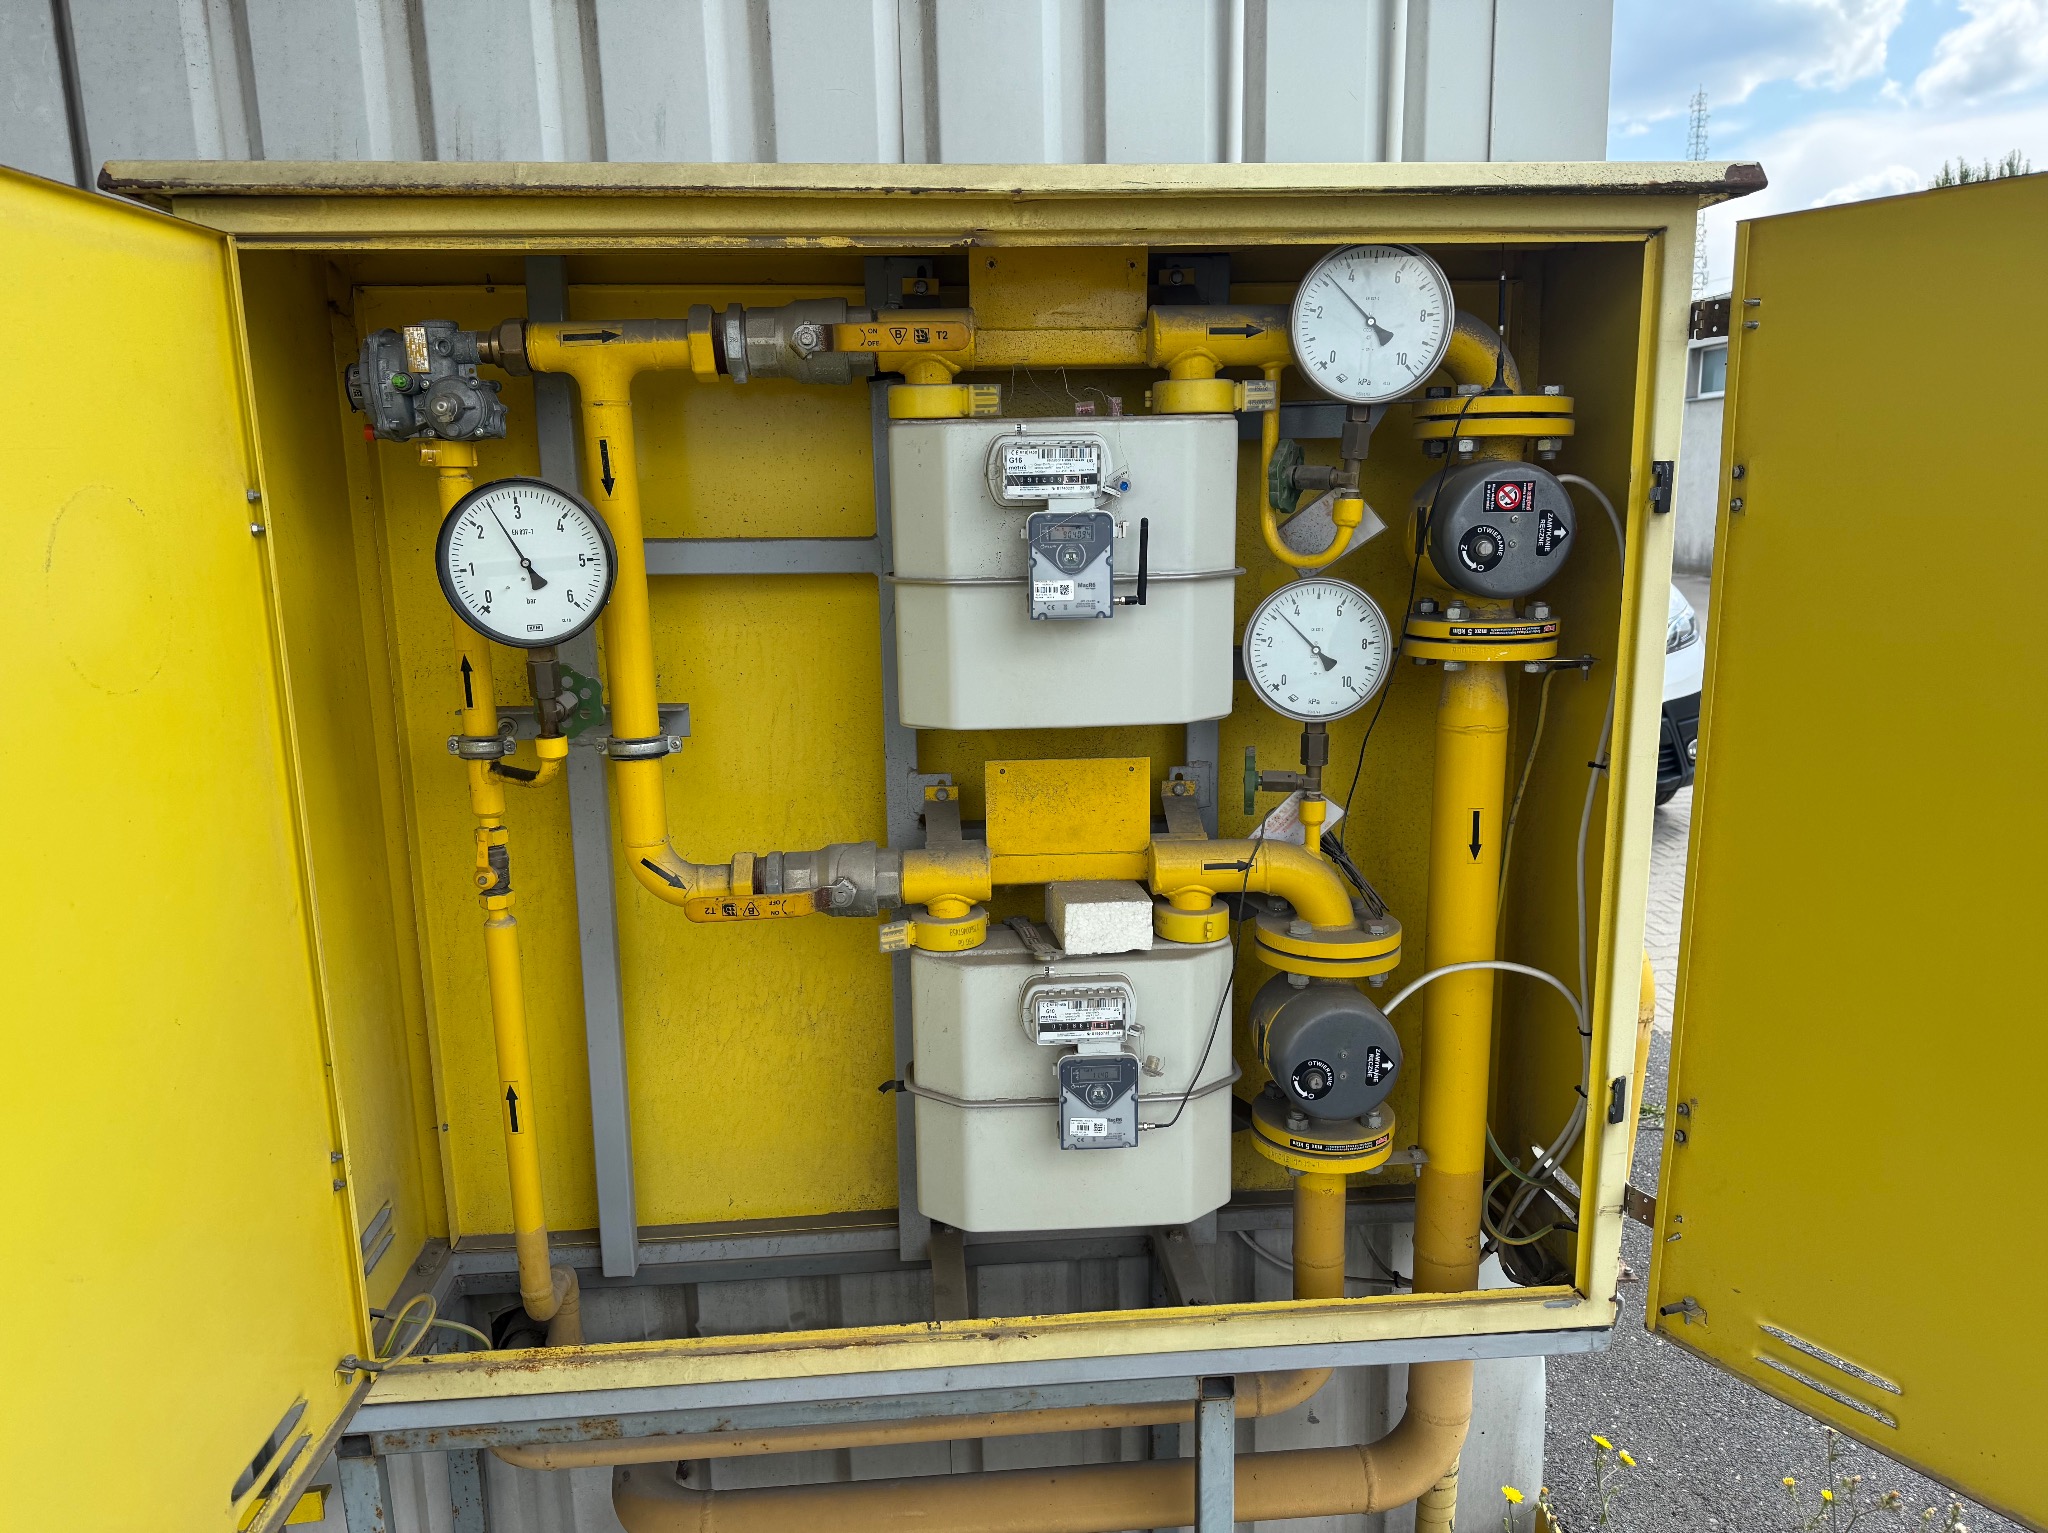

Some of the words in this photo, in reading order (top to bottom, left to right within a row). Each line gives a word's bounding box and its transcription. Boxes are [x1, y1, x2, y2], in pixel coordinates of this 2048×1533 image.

[1348, 269, 1355, 282] 4
[1394, 270, 1401, 284] 6
[1316, 305, 1323, 319] 2
[1419, 309, 1427, 322] 8
[895, 330, 902, 338] B
[936, 331, 948, 340] T2
[1329, 350, 1336, 363] 0
[1396, 352, 1408, 366] 10
[1357, 378, 1372, 386] kPa
[513, 505, 522, 519] 3
[476, 525, 485, 539] 2
[556, 518, 565, 533] 4
[1544, 513, 1554, 552] ZAMYKANIE
[1477, 527, 1504, 556] OTWIERANIE
[578, 553, 586, 567] 5
[468, 562, 475, 576] 1
[484, 590, 493, 603] 0
[566, 589, 574, 603] 6
[1294, 605, 1300, 617] 4
[1336, 605, 1342, 617] 6
[1267, 636, 1273, 648] 2
[1361, 638, 1368, 650] 8
[1281, 674, 1287, 686] 0
[1341, 675, 1352, 688] 10
[1307, 697, 1321, 705] kPa
[704, 907, 717, 915] T2
[747, 907, 754, 915] B
[1373, 1048, 1381, 1083] ZAMYKANIE
[1308, 1060, 1333, 1087] OTWIERANIE
